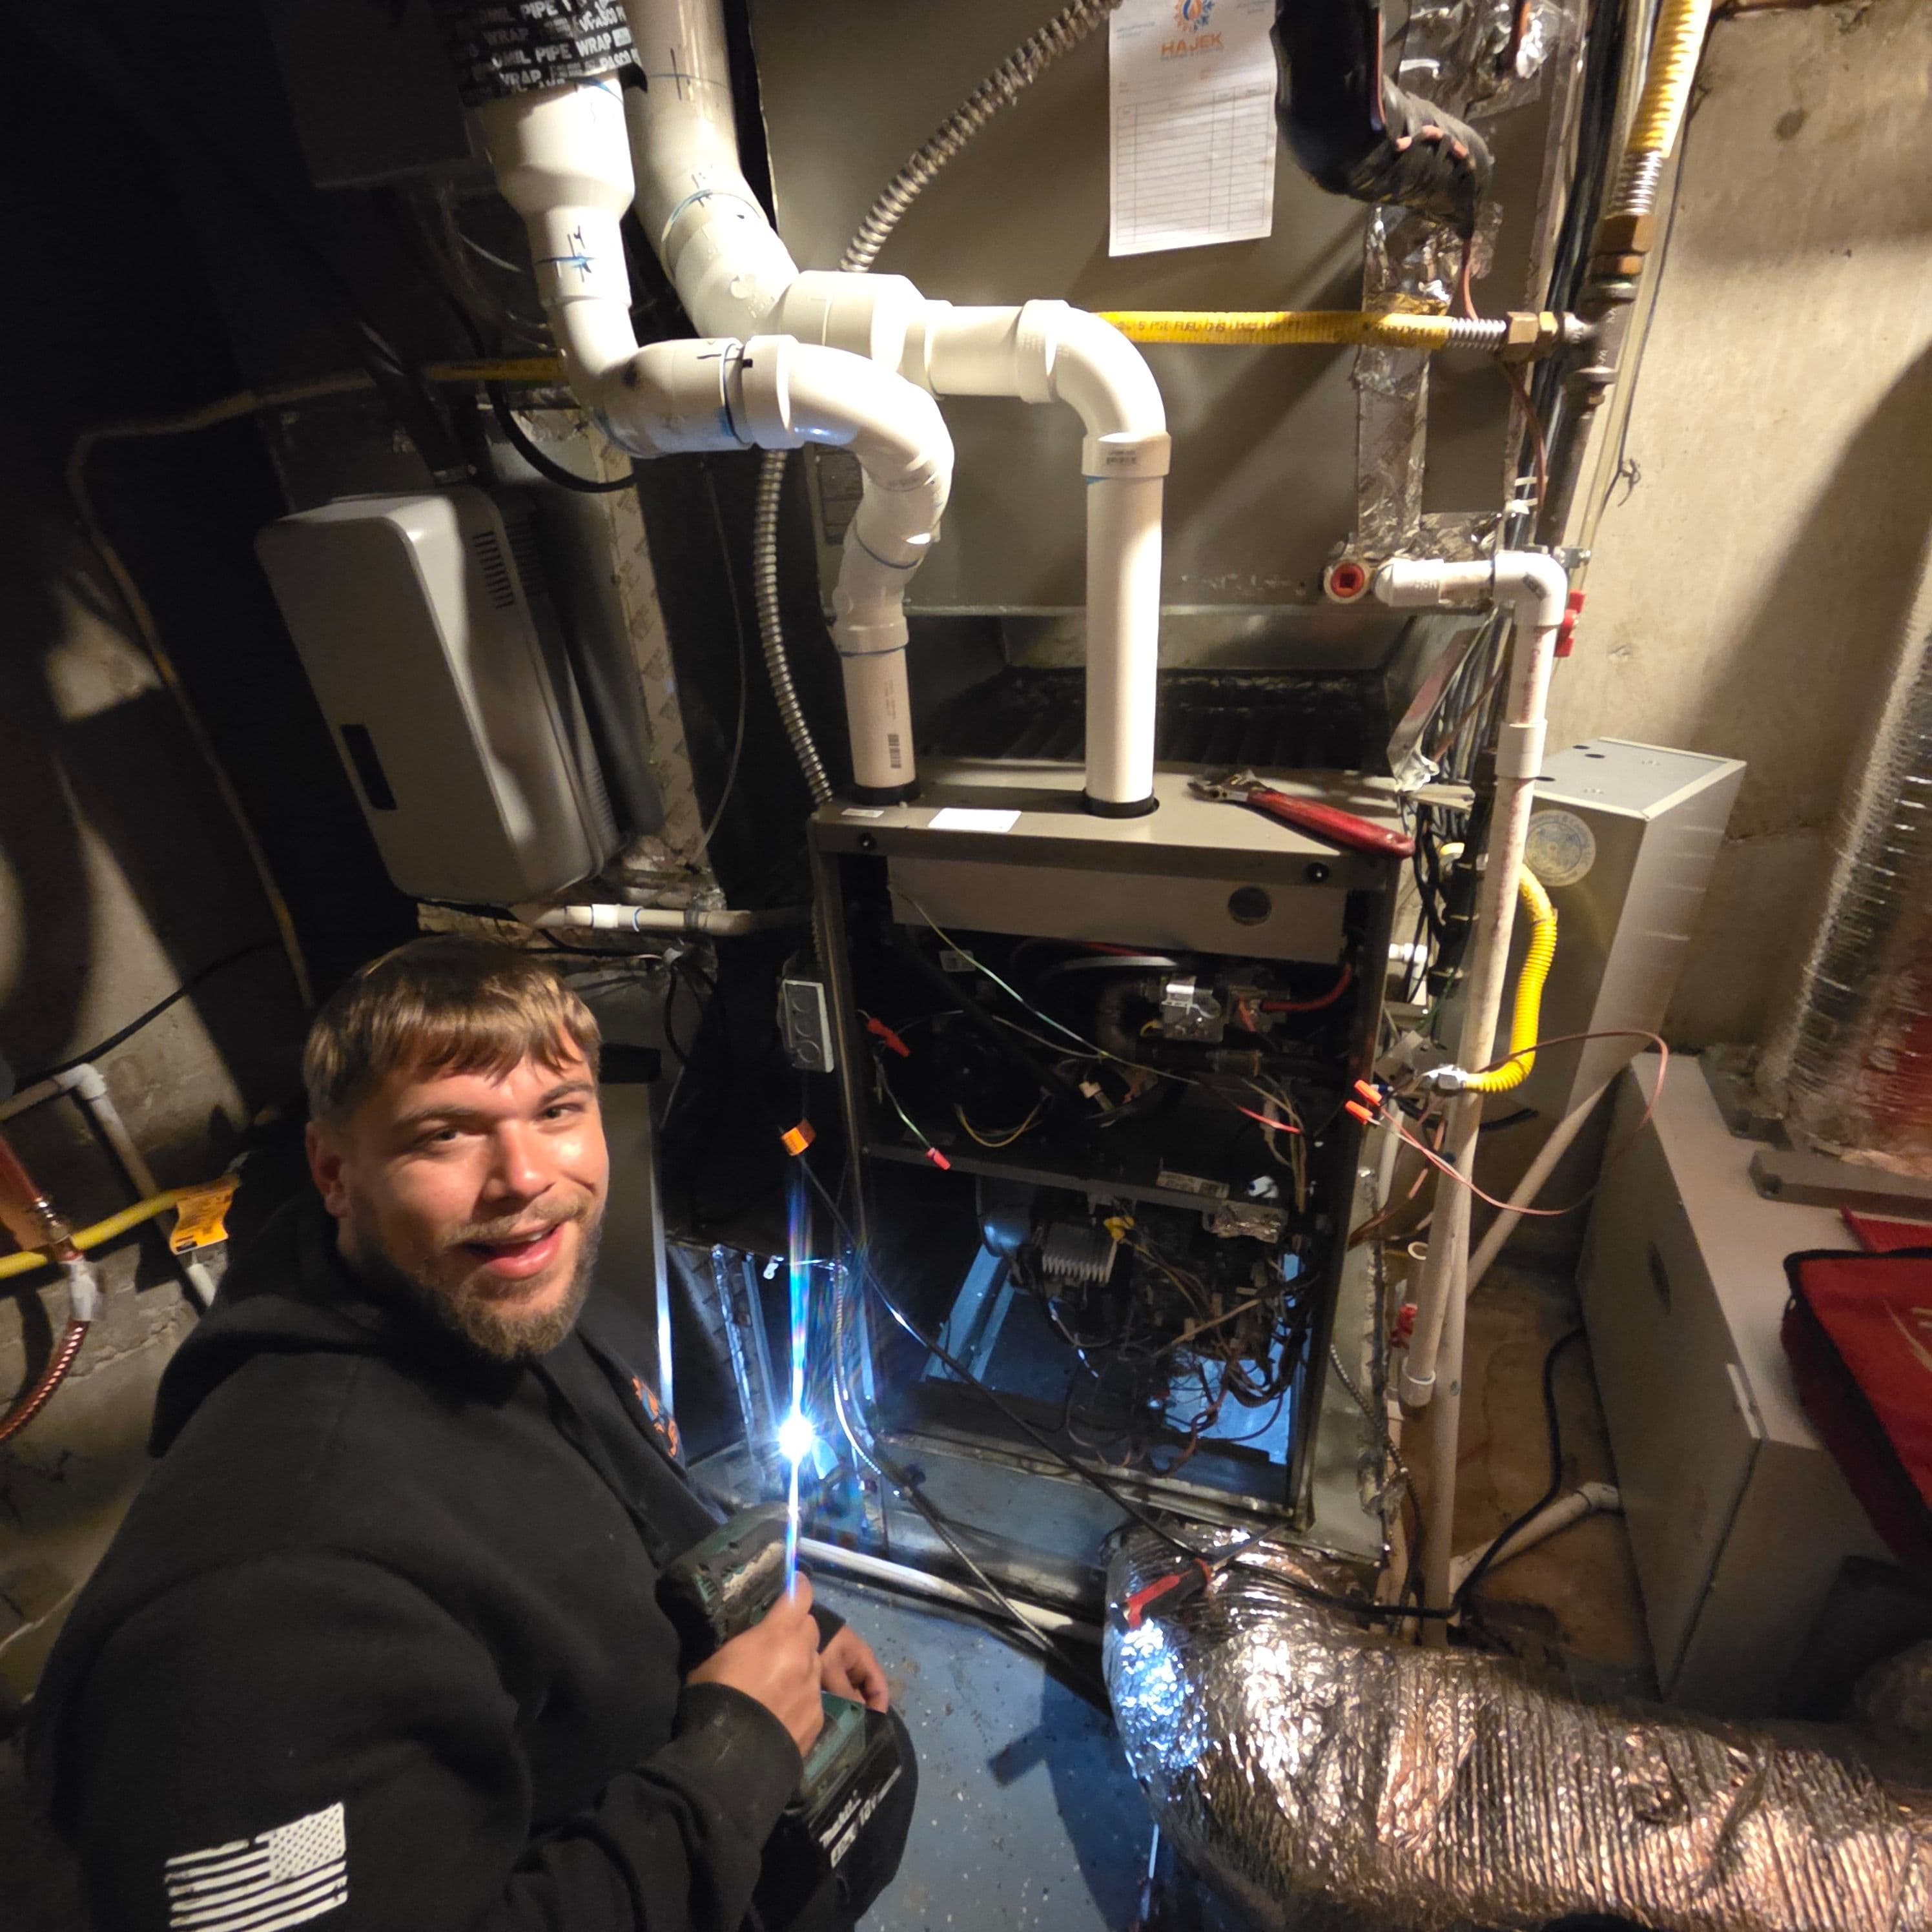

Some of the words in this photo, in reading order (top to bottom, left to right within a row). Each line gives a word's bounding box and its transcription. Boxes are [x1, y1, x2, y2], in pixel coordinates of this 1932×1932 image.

[520, 1, 559, 19] PIPE
[535, 43, 572, 64] PIPE
[575, 32, 611, 57] WRAP
[1160, 32, 1224, 57] HAJEK
